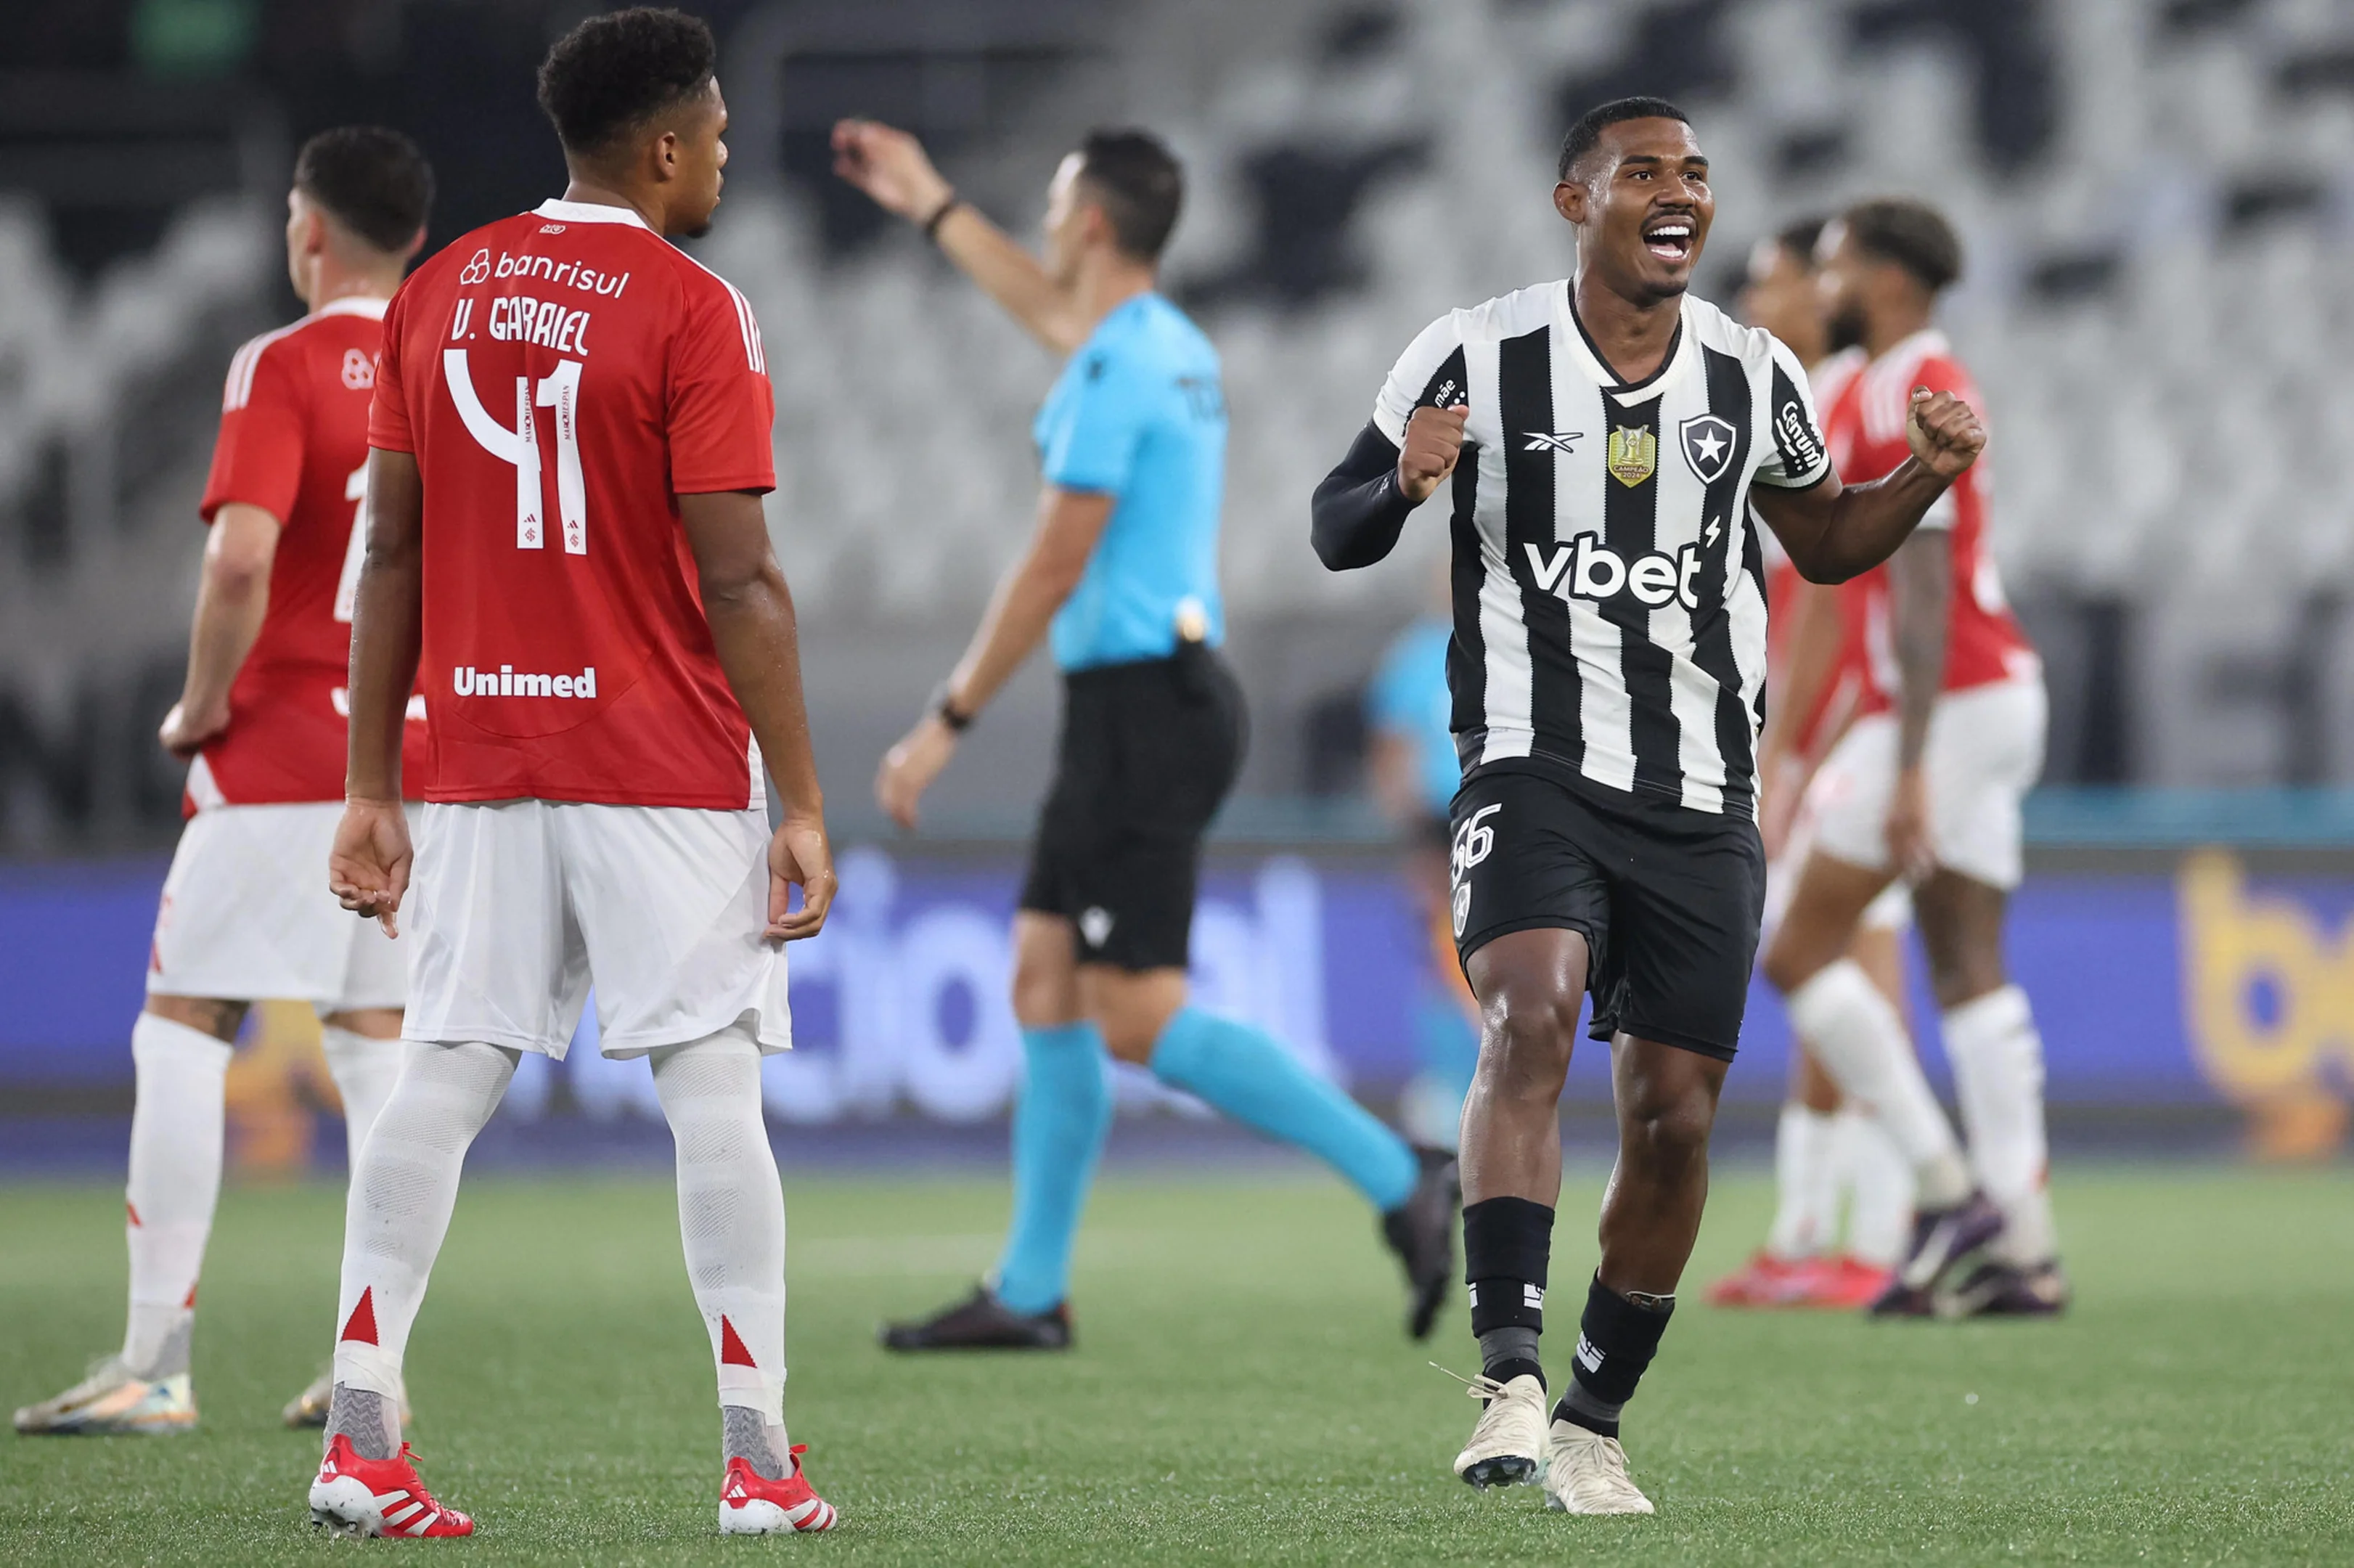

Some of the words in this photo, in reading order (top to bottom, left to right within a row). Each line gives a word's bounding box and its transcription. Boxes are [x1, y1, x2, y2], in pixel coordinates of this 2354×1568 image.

[494, 252, 630, 298] banrisul
[489, 295, 592, 356] GABRIEL
[443, 348, 587, 555] 41
[1613, 465, 1650, 475] CAMPEÃO
[1524, 536, 1701, 609] vbet
[454, 663, 597, 699] Unimed
